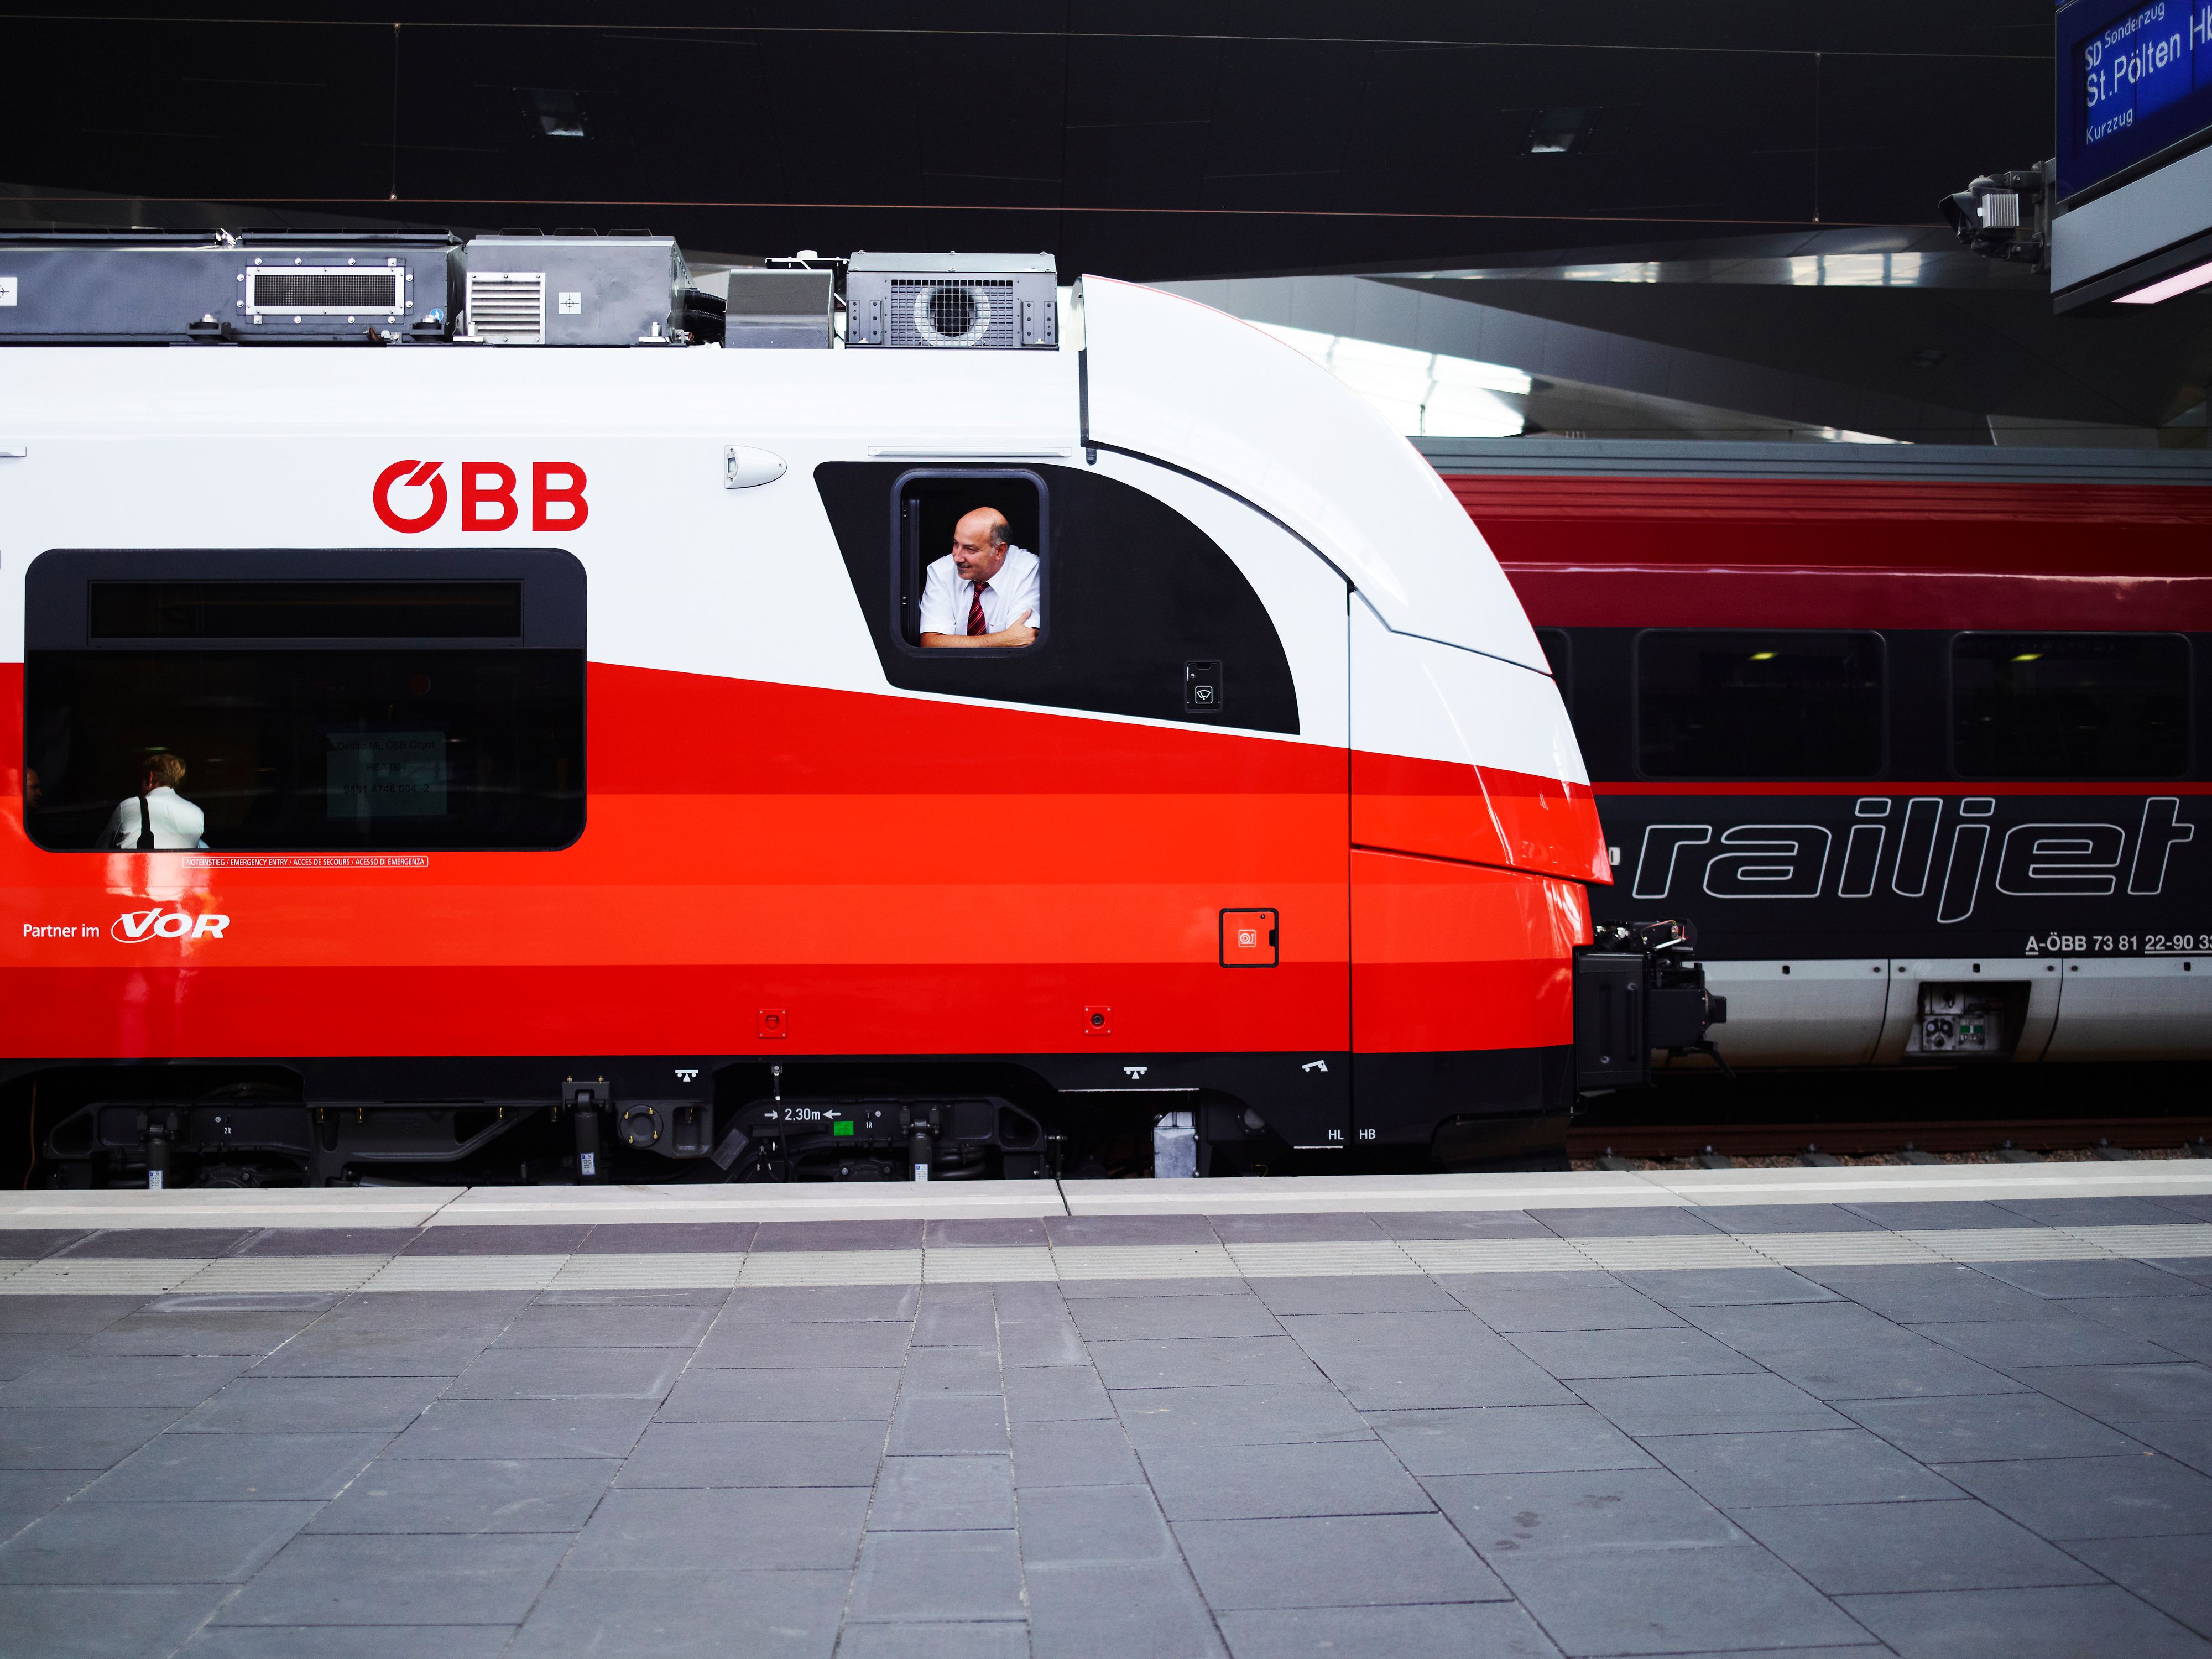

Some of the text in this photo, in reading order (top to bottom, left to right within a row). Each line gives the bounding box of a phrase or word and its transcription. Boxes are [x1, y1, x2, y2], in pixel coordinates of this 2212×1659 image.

[2085, 2, 2164, 71] SD Sonderzug
[2086, 108, 2133, 144] Kurzzug
[373, 460, 588, 534] ÖBB
[337, 741, 367, 750] Desiro
[369, 741, 383, 750] ML
[367, 761, 406, 771] RBA 004
[343, 784, 367, 794] 9481
[371, 784, 395, 794] 4746
[399, 784, 416, 793] 004
[1632, 797, 2194, 924] railjet
[23, 907, 231, 938] Partner im VOR
[2025, 932, 2212, 951] A-ÖBB 73 81 22-90 3
[785, 1108, 821, 1121] 2,30m
[1328, 1129, 1344, 1140] HL
[1359, 1129, 1376, 1139] HB
